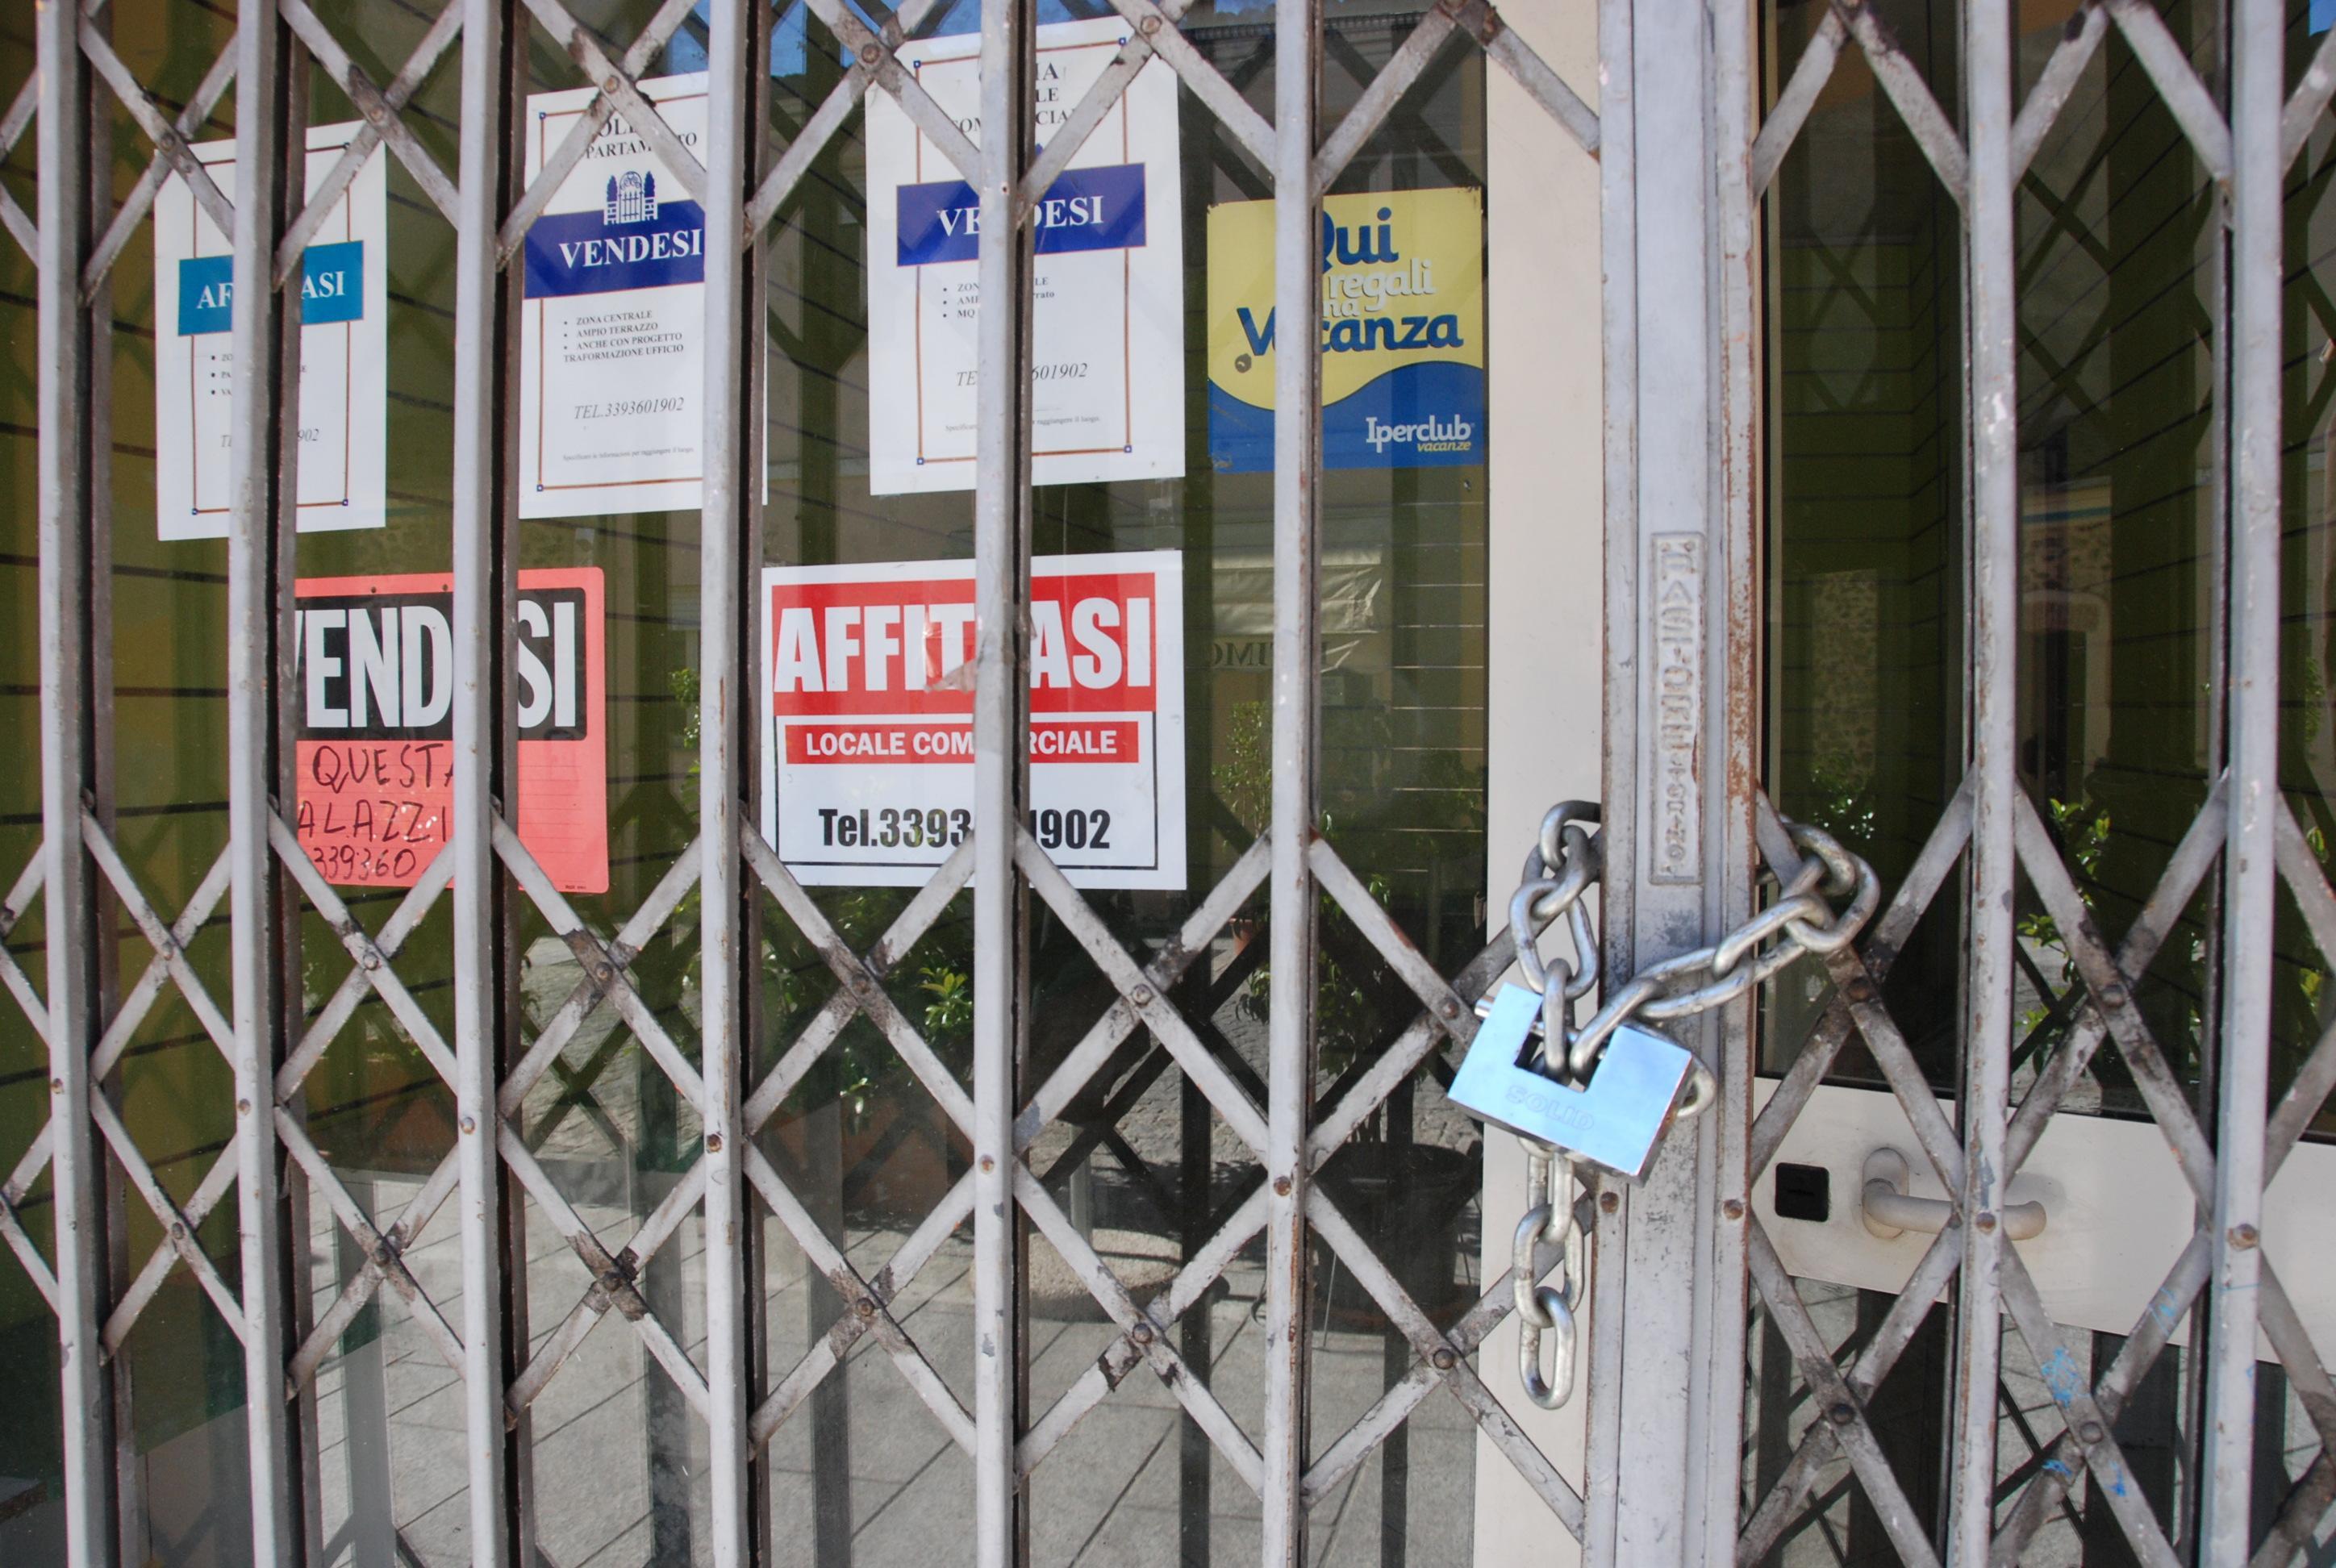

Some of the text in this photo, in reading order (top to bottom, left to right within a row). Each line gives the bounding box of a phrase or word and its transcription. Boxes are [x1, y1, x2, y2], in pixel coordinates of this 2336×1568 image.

[937, 195, 1104, 236] VEESI
[559, 228, 703, 269] VENDESI
[197, 270, 346, 310] AFASI
[1329, 257, 1437, 312] regali
[577, 310, 653, 326] ZONA CENTRALE
[1323, 299, 1361, 319] na
[577, 322, 658, 338] AMPIO TERRAZZO
[577, 332, 682, 350] ANCHE CON PROGETTO
[646, 344, 684, 355] UFFICIO
[574, 397, 684, 419] TEL.3393601902
[1366, 414, 1472, 453] Iperclub
[1416, 441, 1472, 452] vacanze
[295, 598, 576, 728] ENDSI
[773, 598, 1151, 694] AFFITASI
[807, 732, 905, 757] LOCALE
[298, 799, 448, 843] ALAZZI
[819, 808, 1111, 849] Tel.33931902
